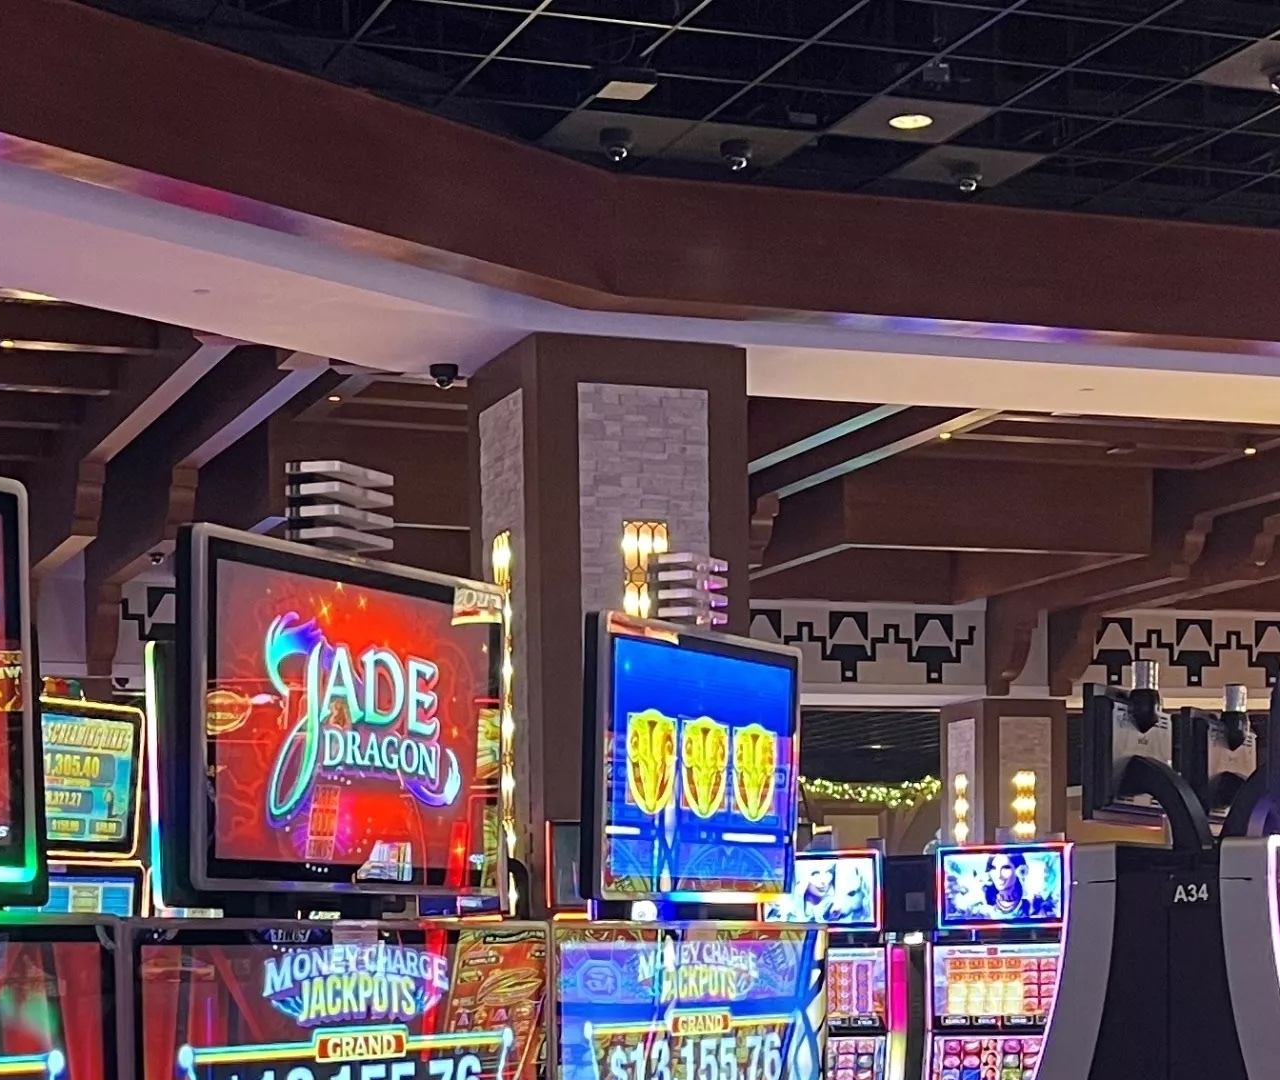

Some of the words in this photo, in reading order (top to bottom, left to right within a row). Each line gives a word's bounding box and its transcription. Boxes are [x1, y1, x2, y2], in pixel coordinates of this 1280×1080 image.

[266, 622, 439, 815] JADE
[323, 727, 439, 782] DRAGON
[1173, 883, 1209, 903] A34
[262, 944, 366, 1000] MONEY
[364, 941, 449, 990] CHARGE
[702, 942, 759, 979] CHARGE
[299, 975, 417, 1021] JACKPOTS
[678, 1014, 723, 1033] GRAND
[326, 1035, 406, 1059] GRAND
